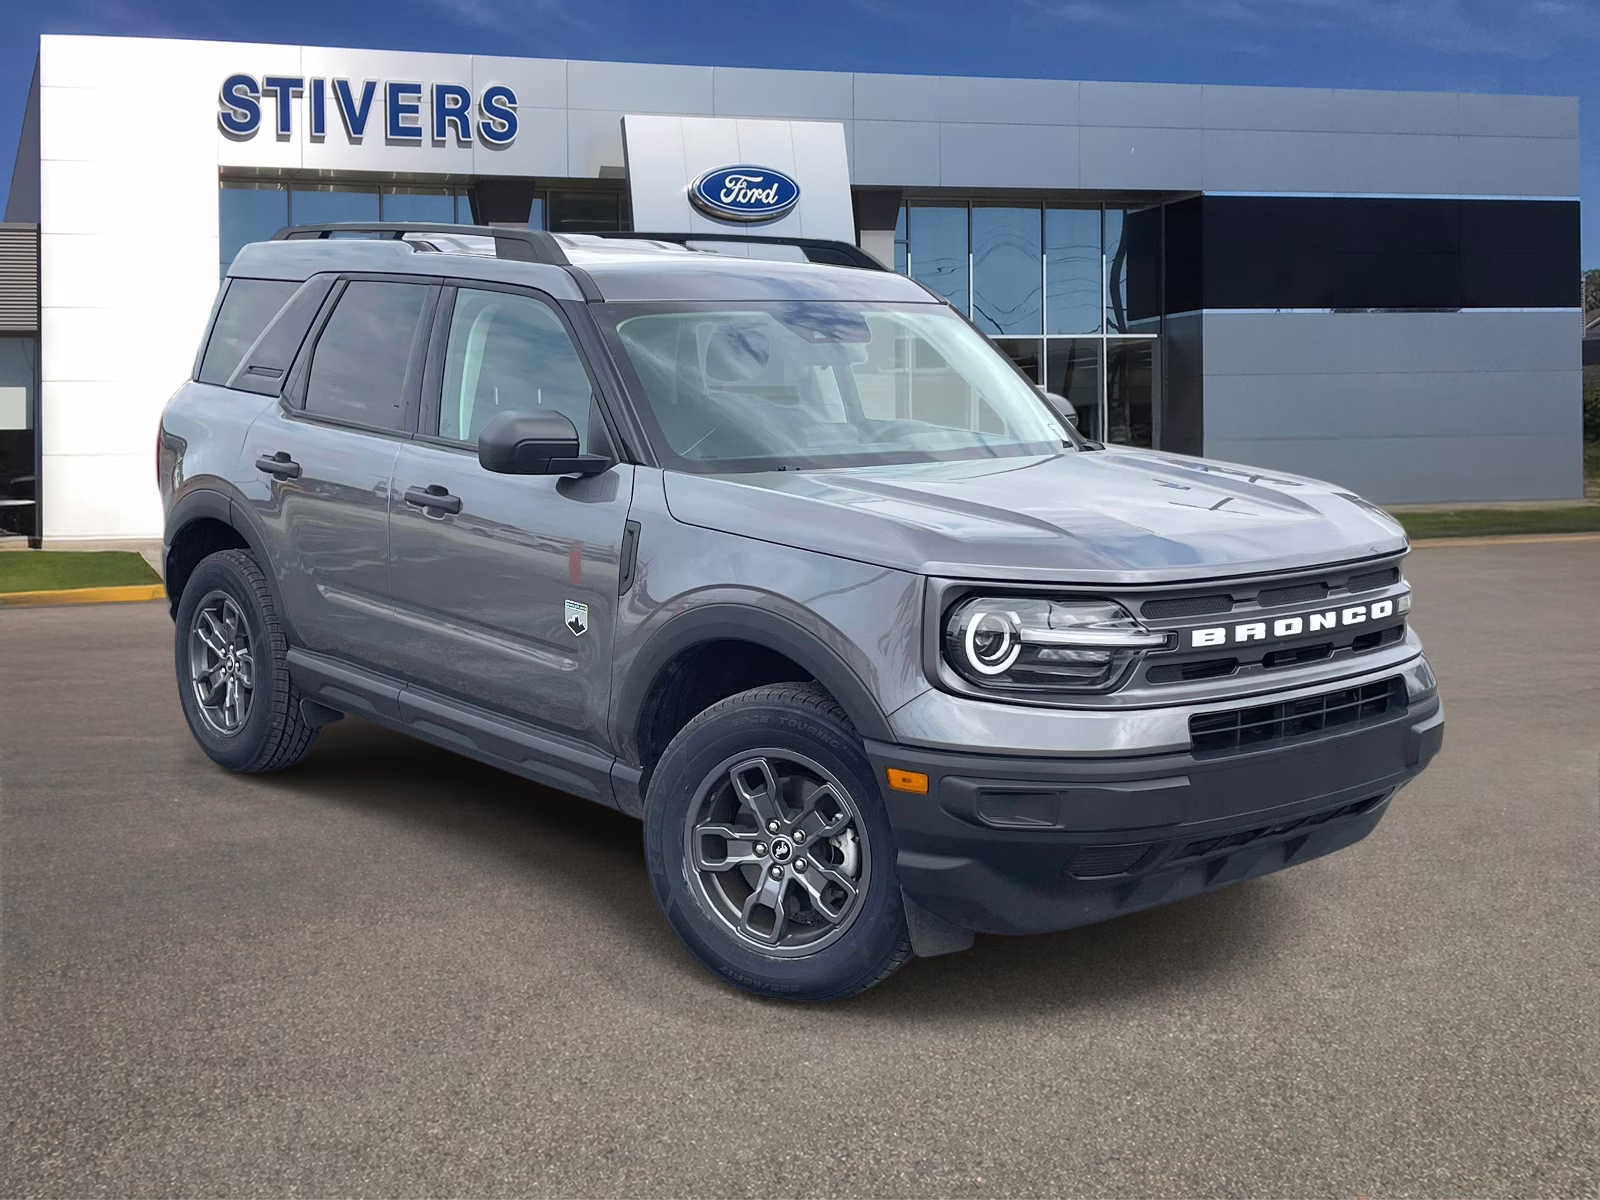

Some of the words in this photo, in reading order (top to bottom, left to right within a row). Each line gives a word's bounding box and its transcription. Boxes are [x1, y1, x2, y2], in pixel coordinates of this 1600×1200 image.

[217, 72, 519, 147] STIVERS
[720, 174, 779, 204] Ford
[1191, 600, 1393, 648] BRONCO
[778, 716, 841, 749] TOURING
